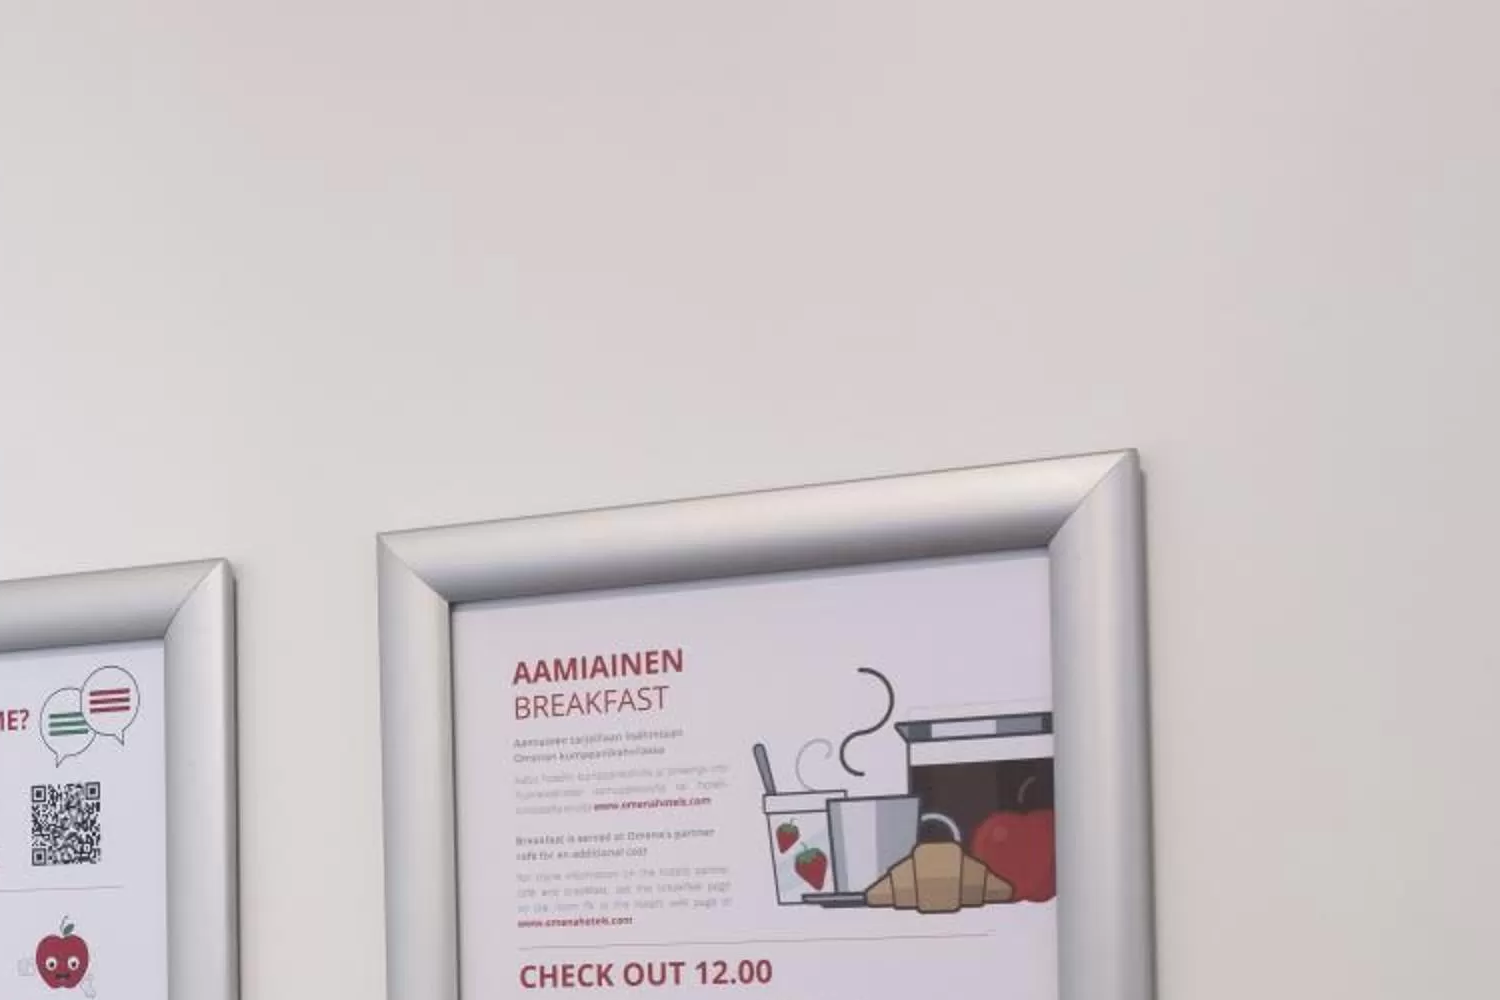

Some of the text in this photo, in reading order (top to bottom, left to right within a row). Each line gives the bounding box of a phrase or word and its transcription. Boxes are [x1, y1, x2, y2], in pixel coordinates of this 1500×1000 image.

[512, 647, 684, 685] AAMIAINEN
[514, 685, 670, 720] BREAKFAST
[519, 958, 773, 989] CHECK OUT 12.00
